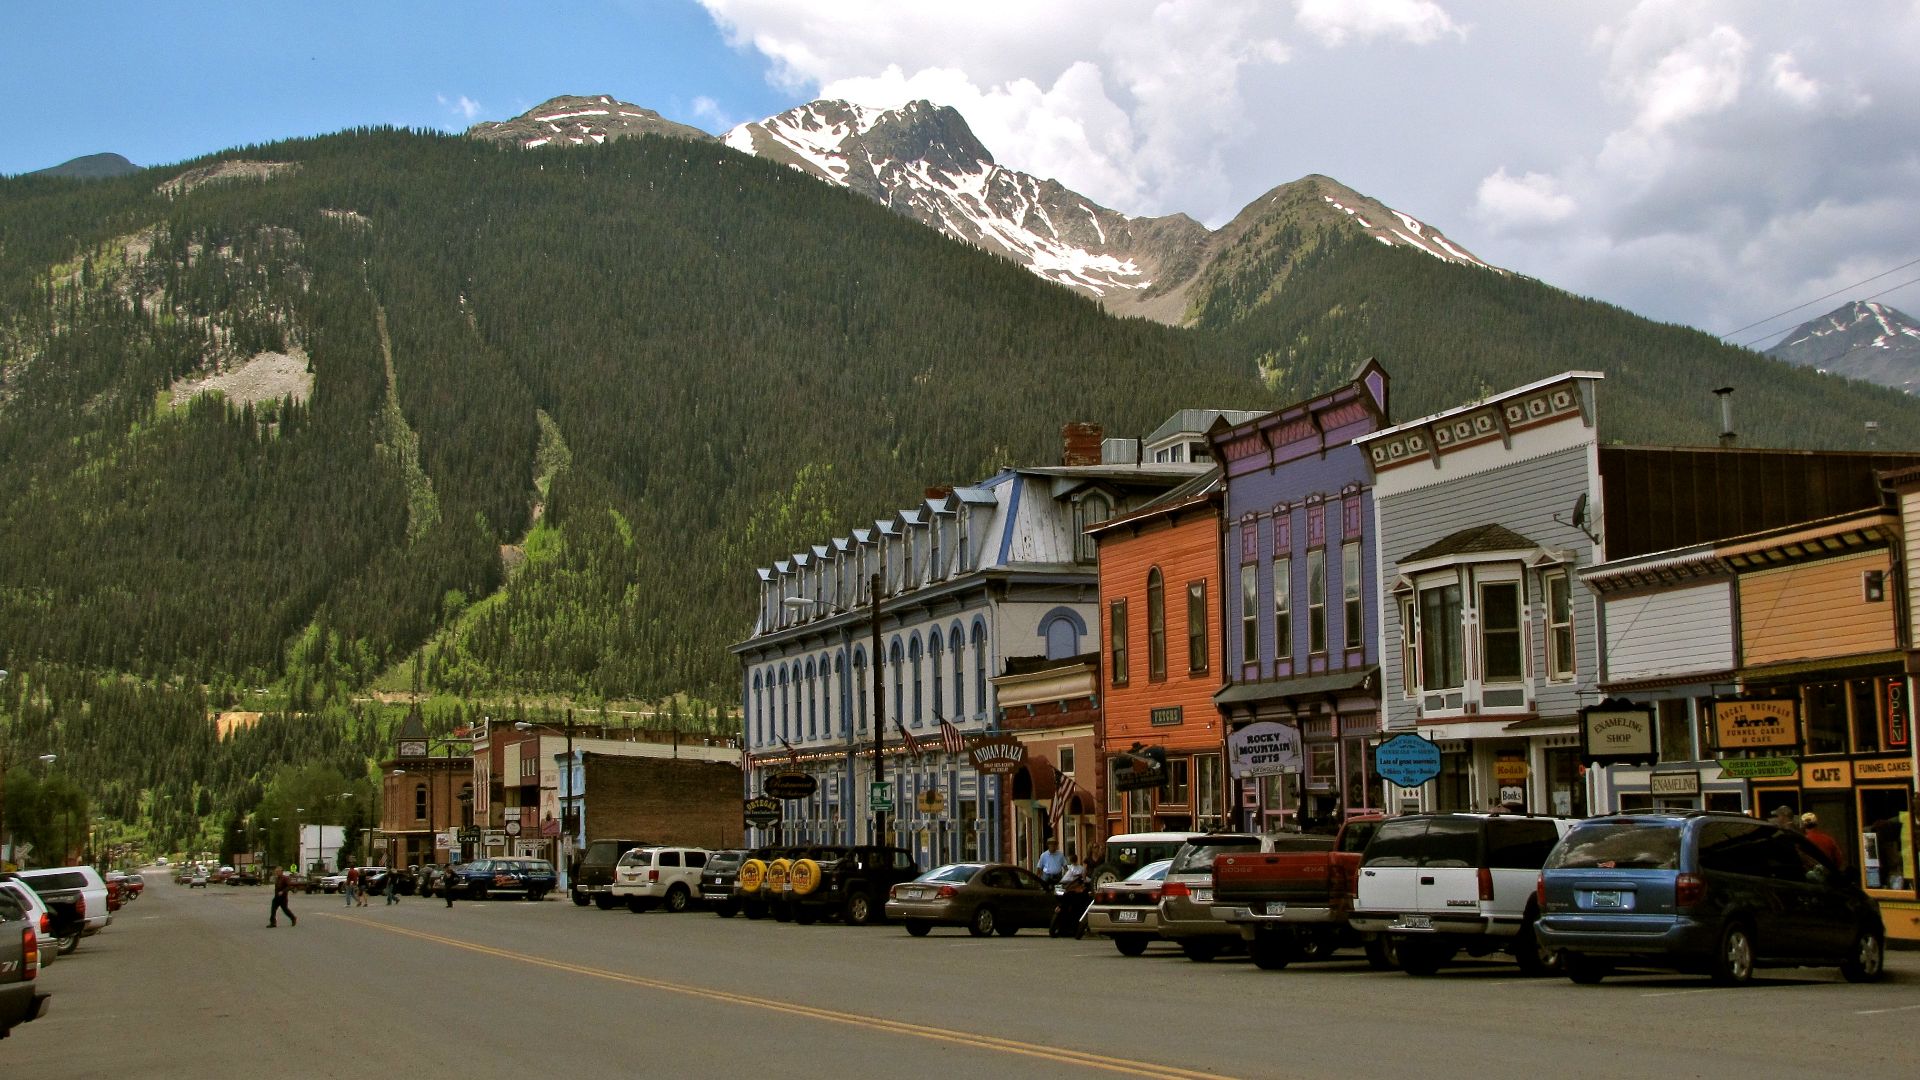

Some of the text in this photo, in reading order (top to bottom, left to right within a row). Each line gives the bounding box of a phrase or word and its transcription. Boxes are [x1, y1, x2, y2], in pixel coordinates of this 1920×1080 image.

[1720, 703, 1790, 720] ROCKY MOUNTAIN
[1890, 687, 1901, 741] OPEN
[1593, 717, 1643, 734] ENAMELING
[1727, 727, 1785, 736] FUNNEL CAKES
[1246, 732, 1280, 744] ROCKY
[1606, 733, 1632, 743] SHOP
[974, 744, 1023, 763] INDIAN PLAZA
[1239, 742, 1290, 755] MOUNTAIN
[1251, 754, 1280, 764] GIFTS
[1497, 766, 1524, 775] Kodak
[1858, 762, 1911, 773] FUNNEL CAKES
[1812, 767, 1841, 782] CAFE
[1653, 778, 1696, 791] ENAMELING
[1502, 791, 1521, 801] Books
